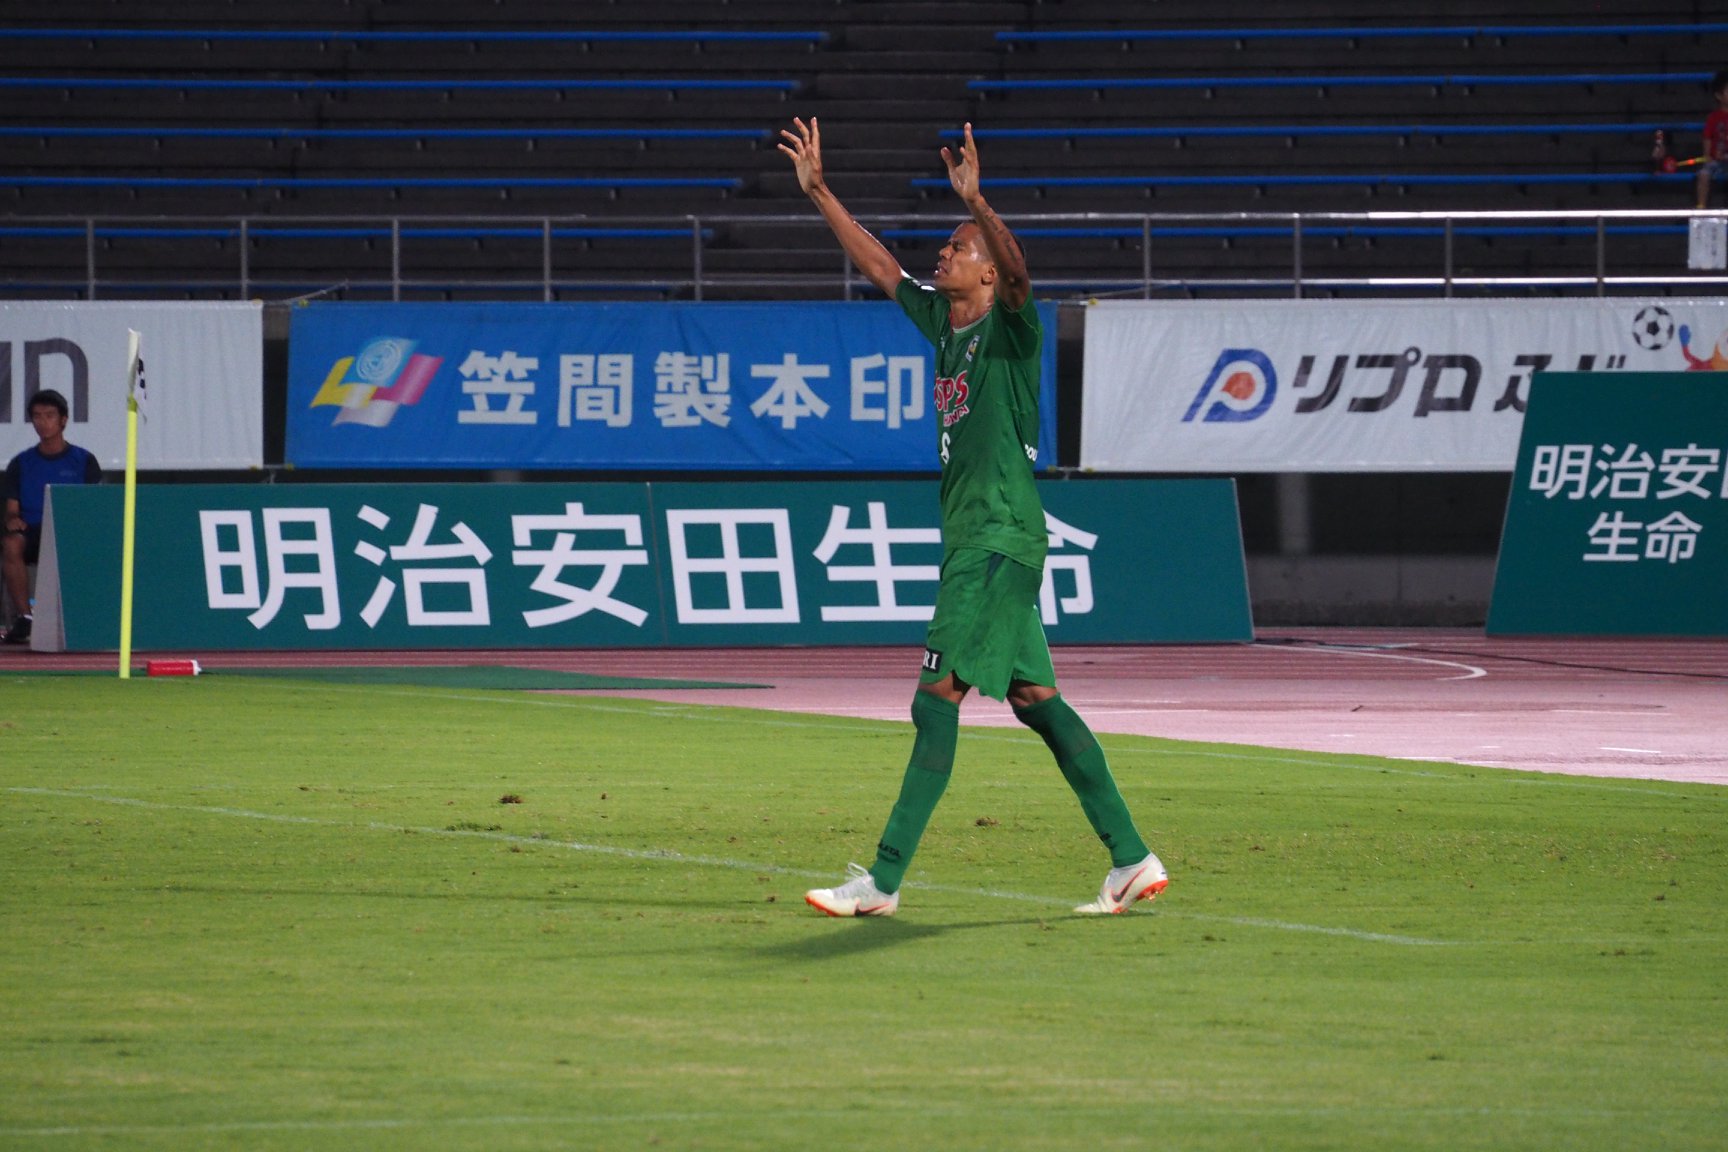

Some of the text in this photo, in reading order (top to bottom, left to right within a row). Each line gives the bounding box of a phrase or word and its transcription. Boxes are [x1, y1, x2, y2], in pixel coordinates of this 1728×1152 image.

[457, 350, 926, 430] 笠間製本印
[1529, 443, 1728, 500] 明治安
[1582, 511, 1703, 564] 生命
